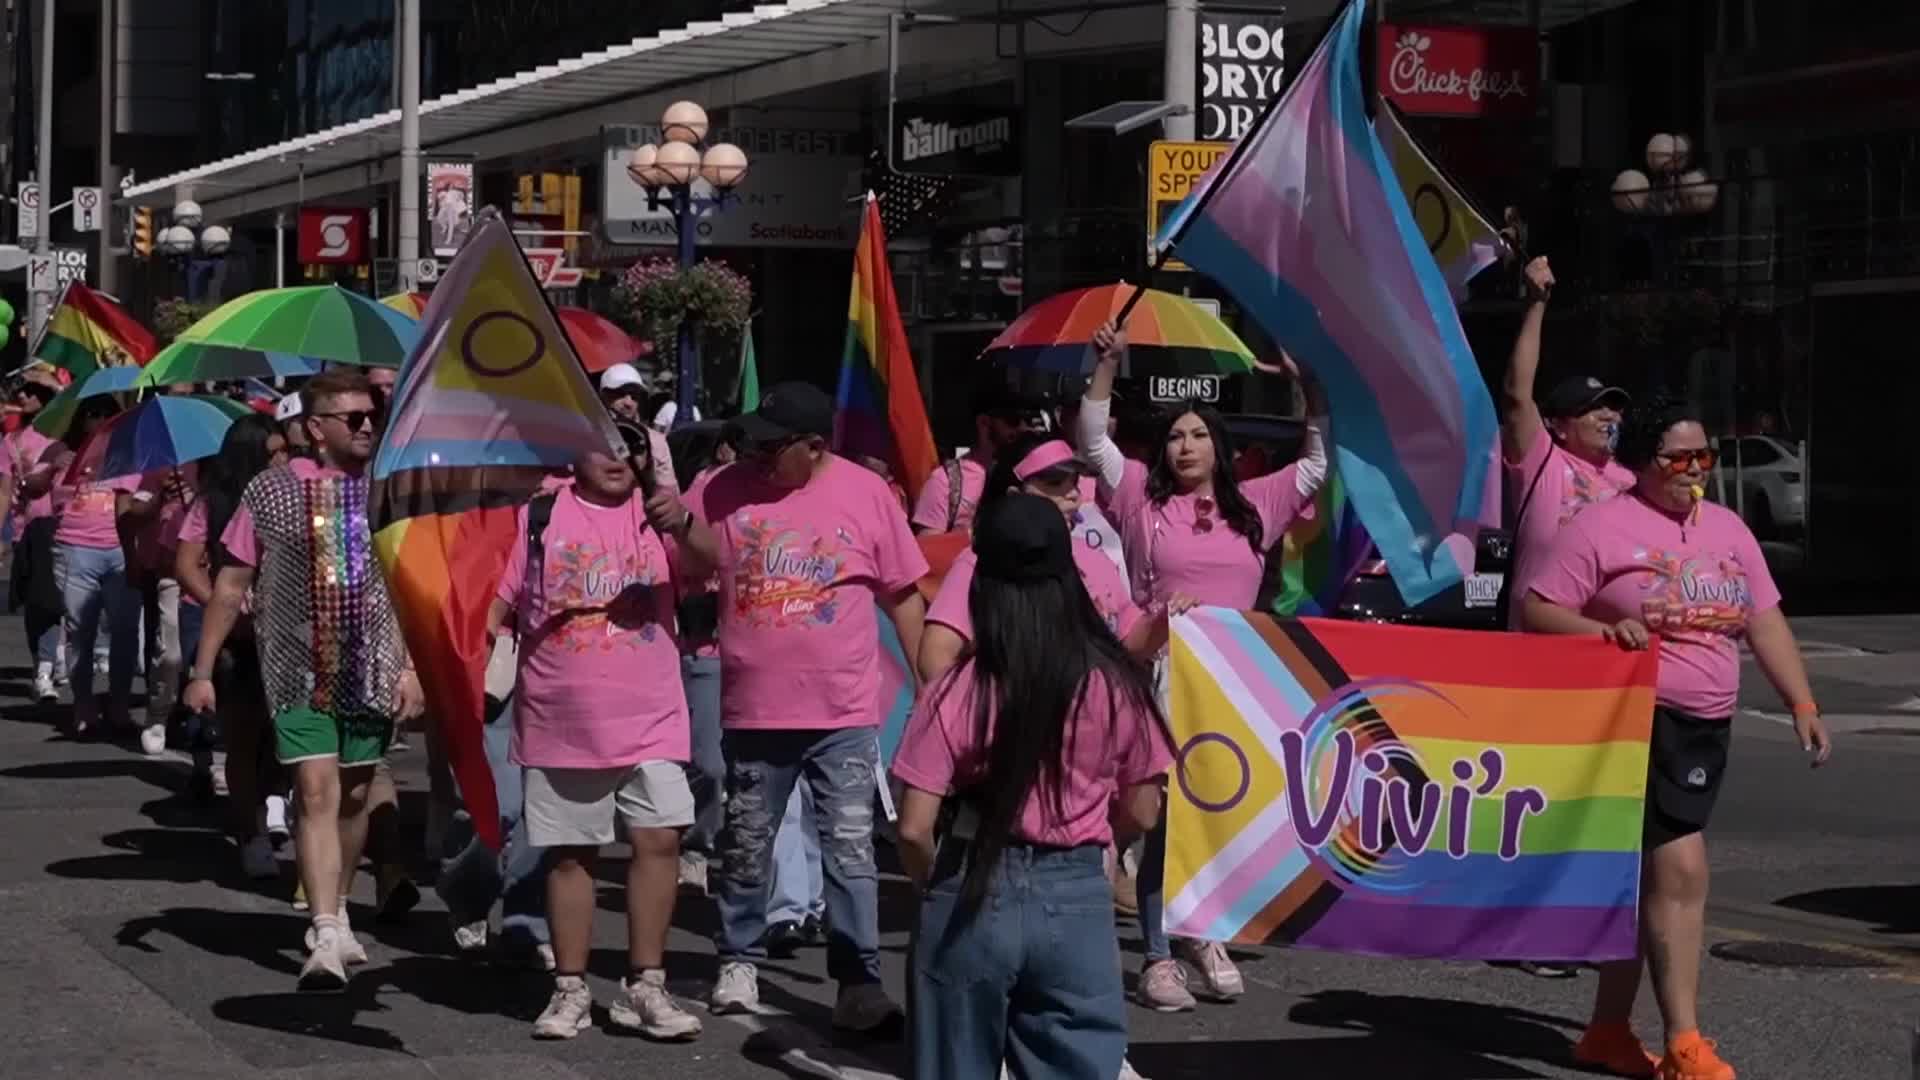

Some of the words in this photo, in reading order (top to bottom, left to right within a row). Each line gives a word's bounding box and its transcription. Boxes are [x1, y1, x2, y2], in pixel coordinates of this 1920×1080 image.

[902, 116, 1009, 161] ballroom
[631, 220, 712, 236] MANO
[1157, 377, 1212, 397] BEGINS
[1278, 728, 1545, 862] Vivi'r
